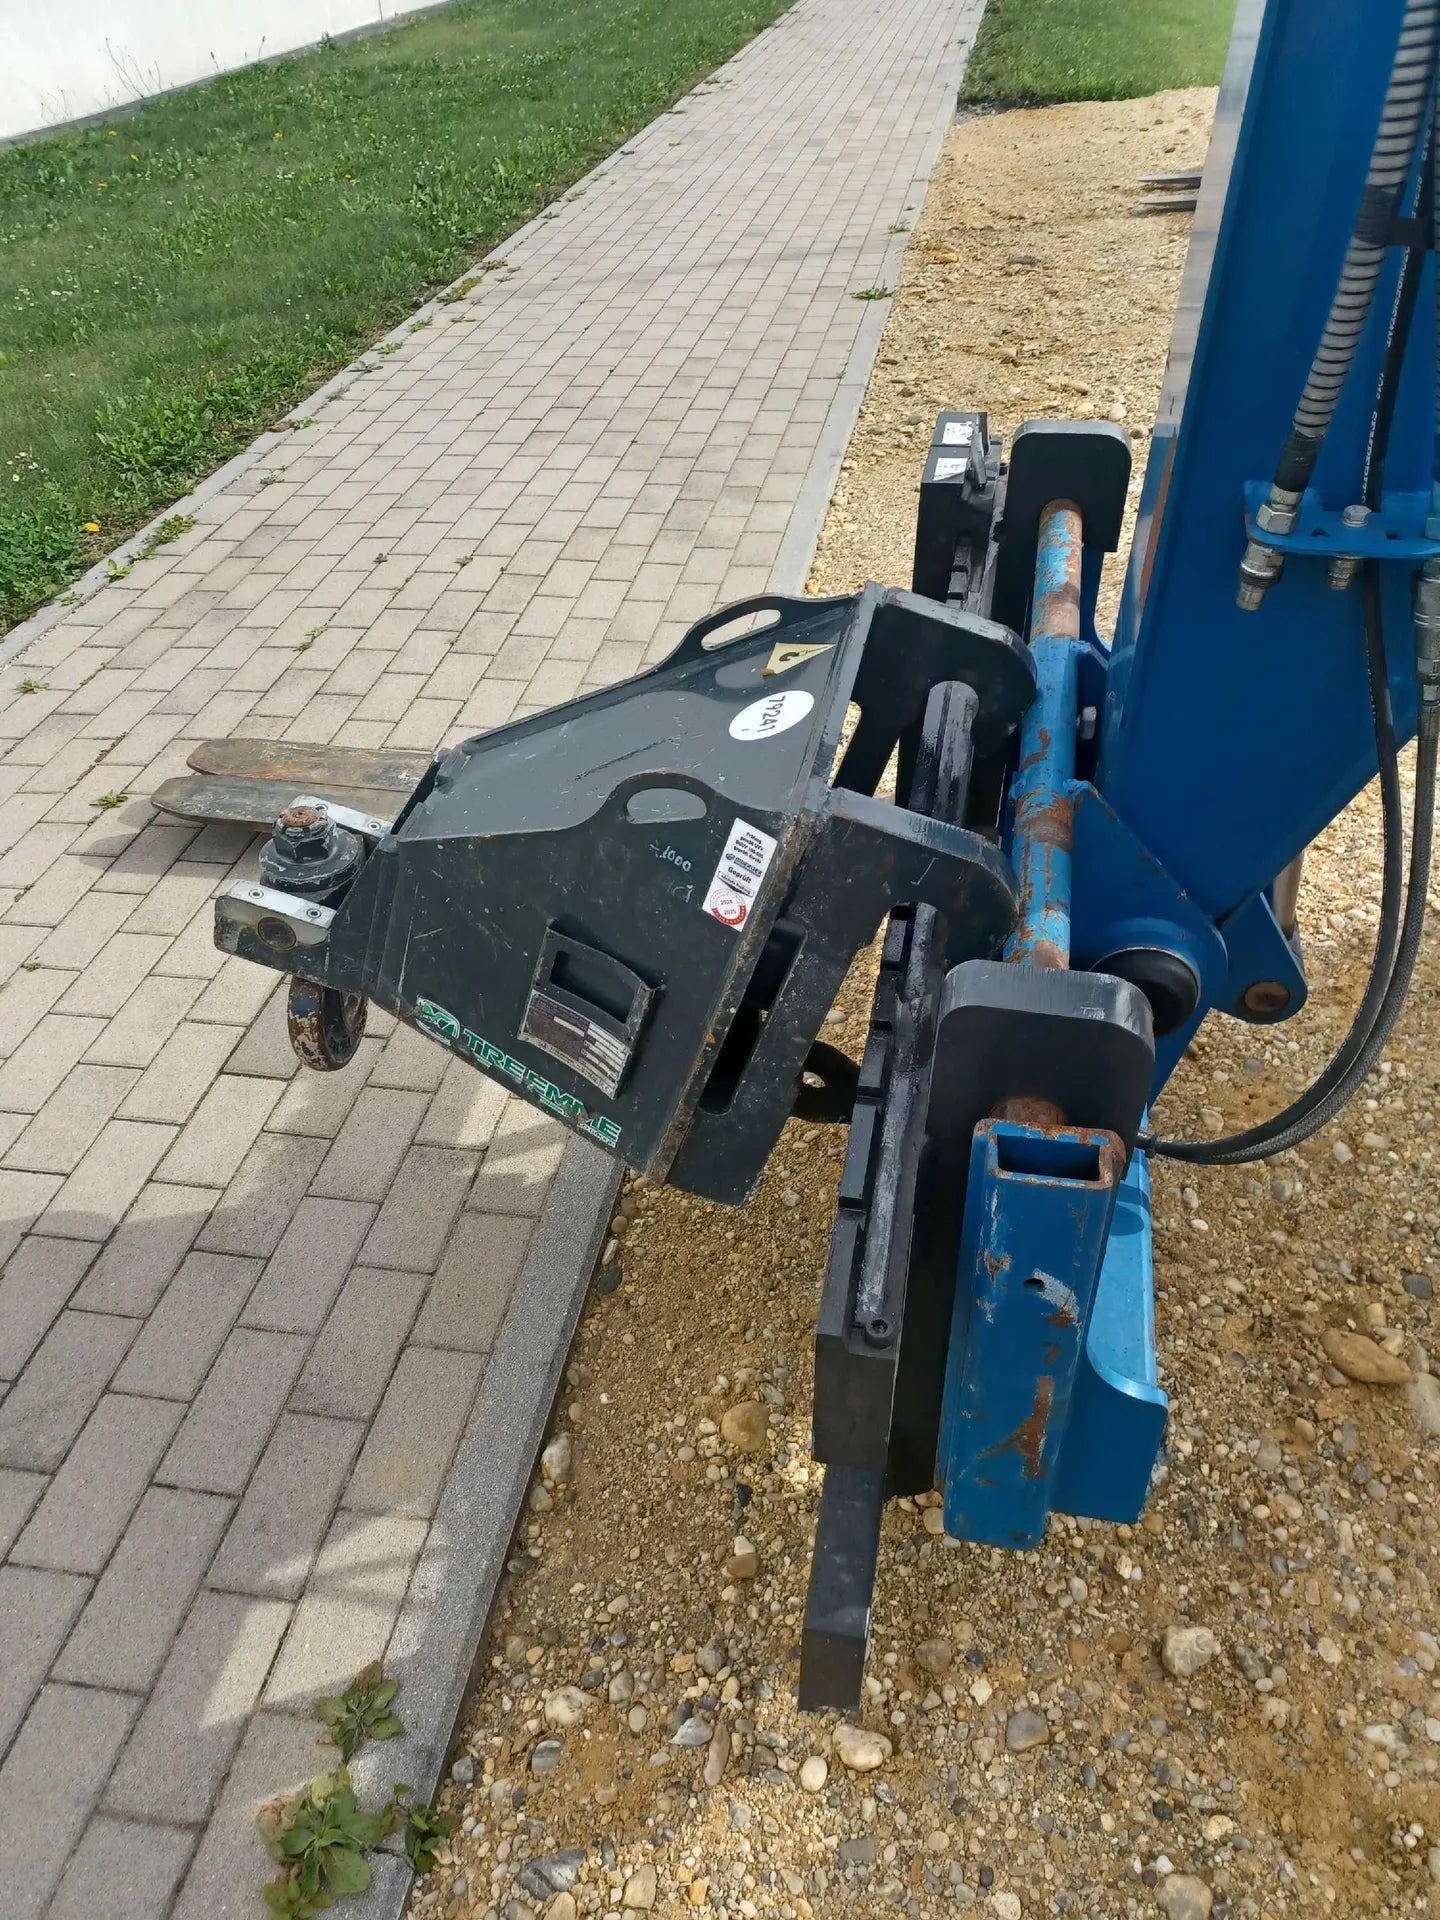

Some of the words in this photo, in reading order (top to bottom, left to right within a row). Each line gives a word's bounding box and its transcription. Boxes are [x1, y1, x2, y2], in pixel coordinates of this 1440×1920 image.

[757, 695, 786, 733] 79241
[728, 866, 752, 884] Geprüft
[463, 1028, 526, 1084] TRE
